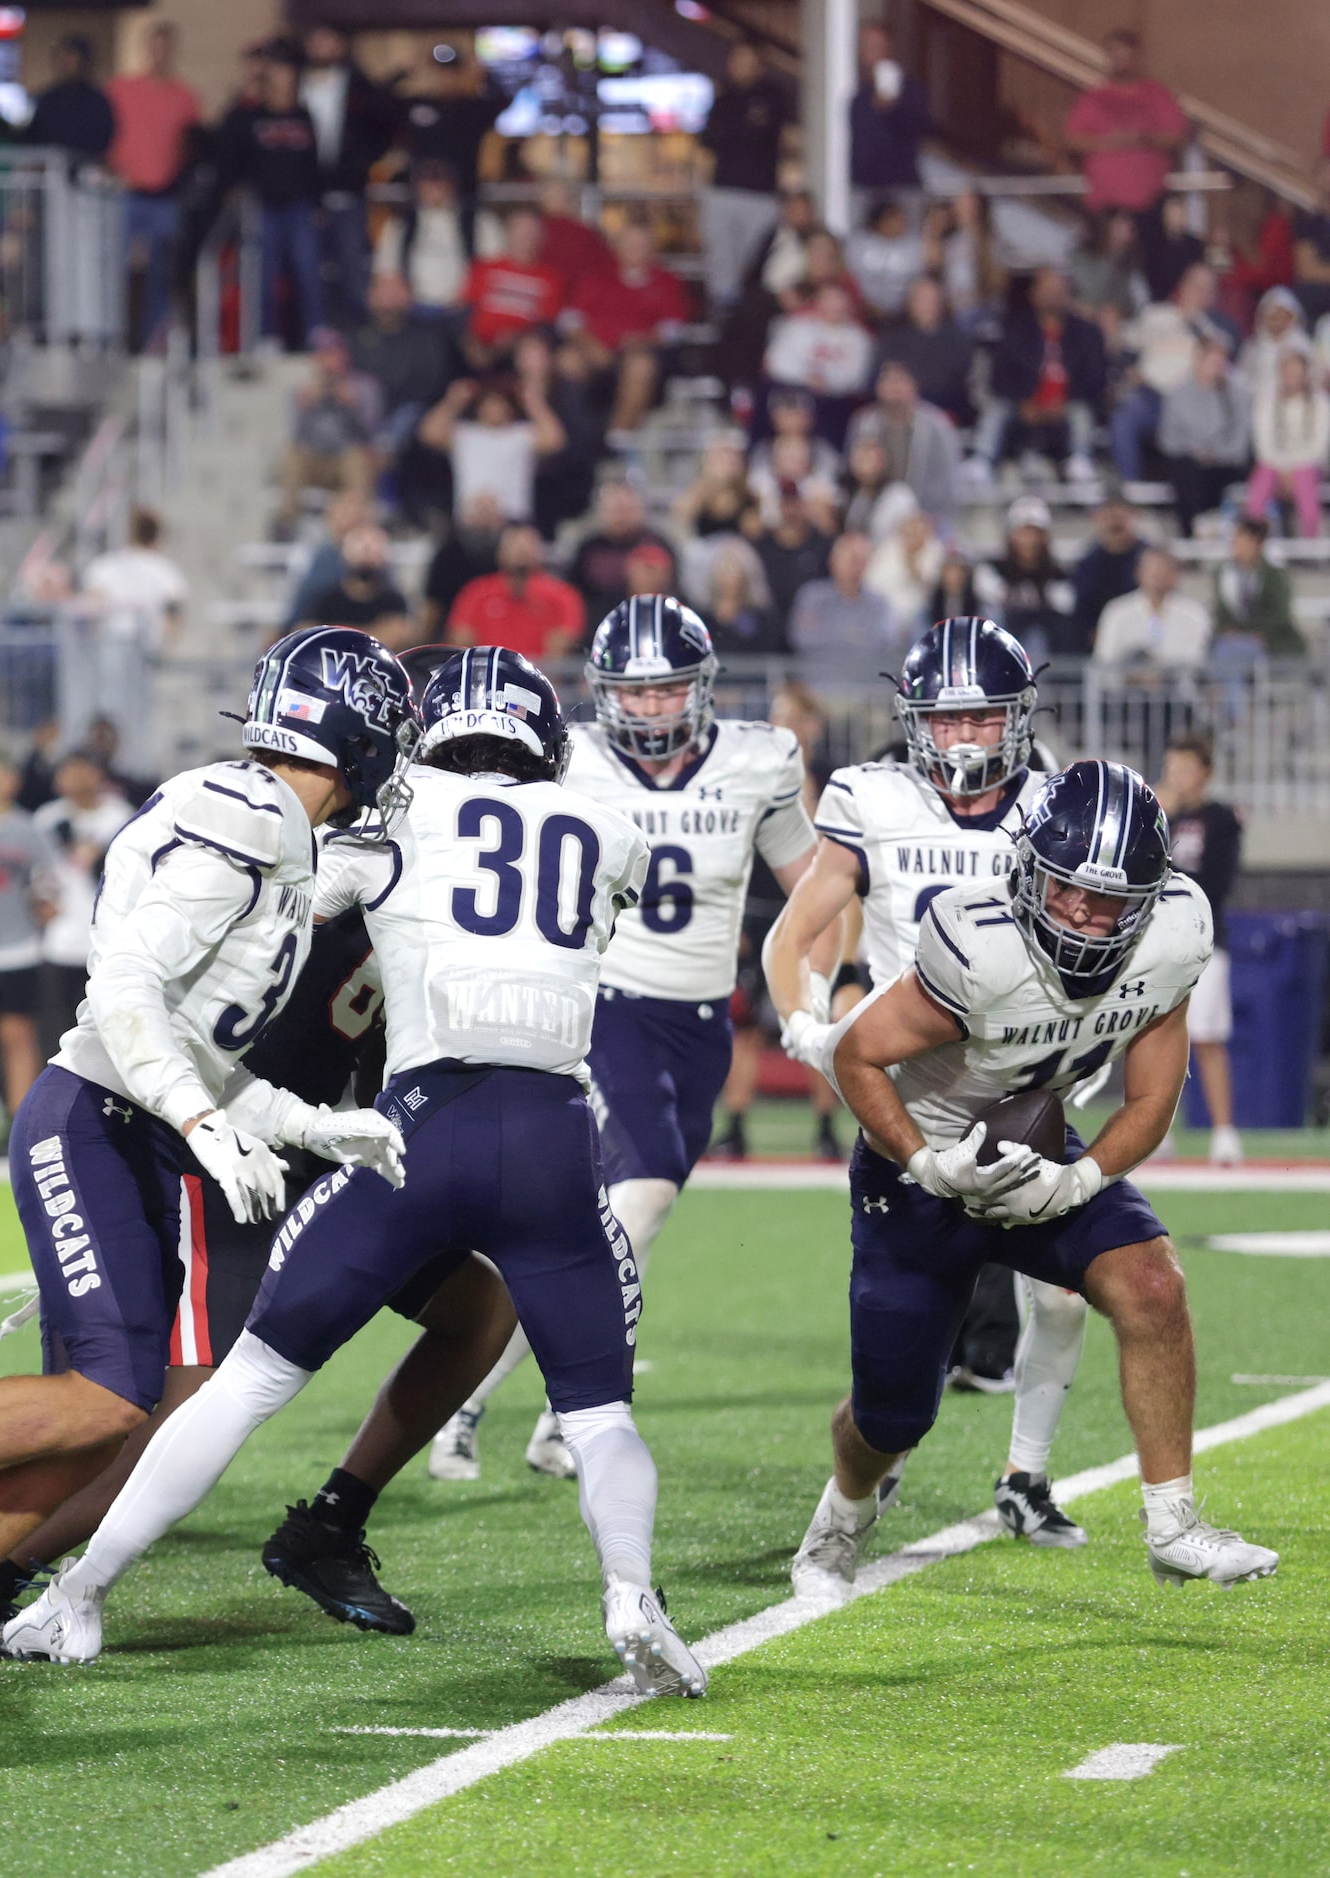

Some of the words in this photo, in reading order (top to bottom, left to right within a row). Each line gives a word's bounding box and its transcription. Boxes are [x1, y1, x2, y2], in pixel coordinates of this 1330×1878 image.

[243, 725, 298, 752] WILDCATS
[440, 713, 517, 735] WDCTS
[681, 810, 739, 835] GROVE
[451, 797, 600, 950] 30
[897, 846, 979, 877] WALNUT
[1085, 865, 1098, 875] THE
[1100, 868, 1124, 880] GROVE
[641, 844, 694, 934] 6
[445, 980, 581, 1050] WANTED
[1001, 1016, 1084, 1045] WALNUT
[1094, 1004, 1159, 1035] GROVE
[29, 1135, 102, 1298] WILDCATS
[269, 1163, 355, 1272] WILDCA
